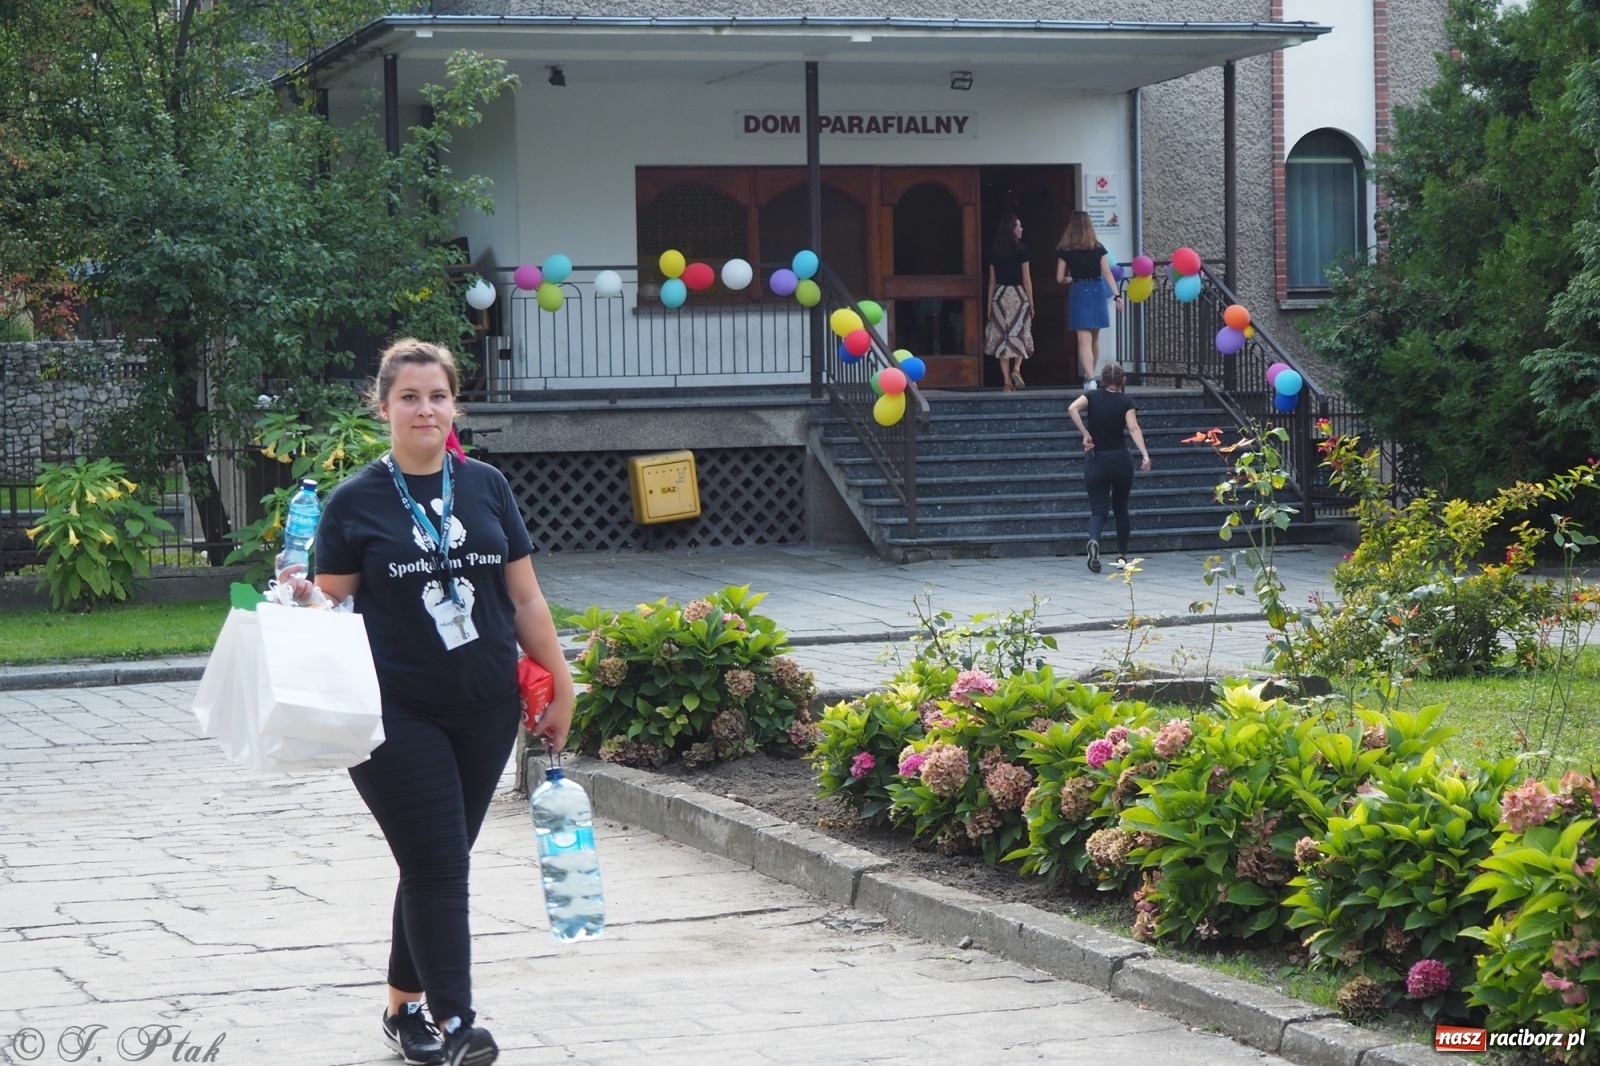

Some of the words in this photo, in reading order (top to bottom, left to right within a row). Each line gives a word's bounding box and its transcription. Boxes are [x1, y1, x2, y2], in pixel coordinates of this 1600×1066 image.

[743, 115, 800, 134] DOM
[818, 115, 969, 134] PARAFIALNY
[661, 486, 676, 494] GAZ
[465, 552, 502, 567] Pana
